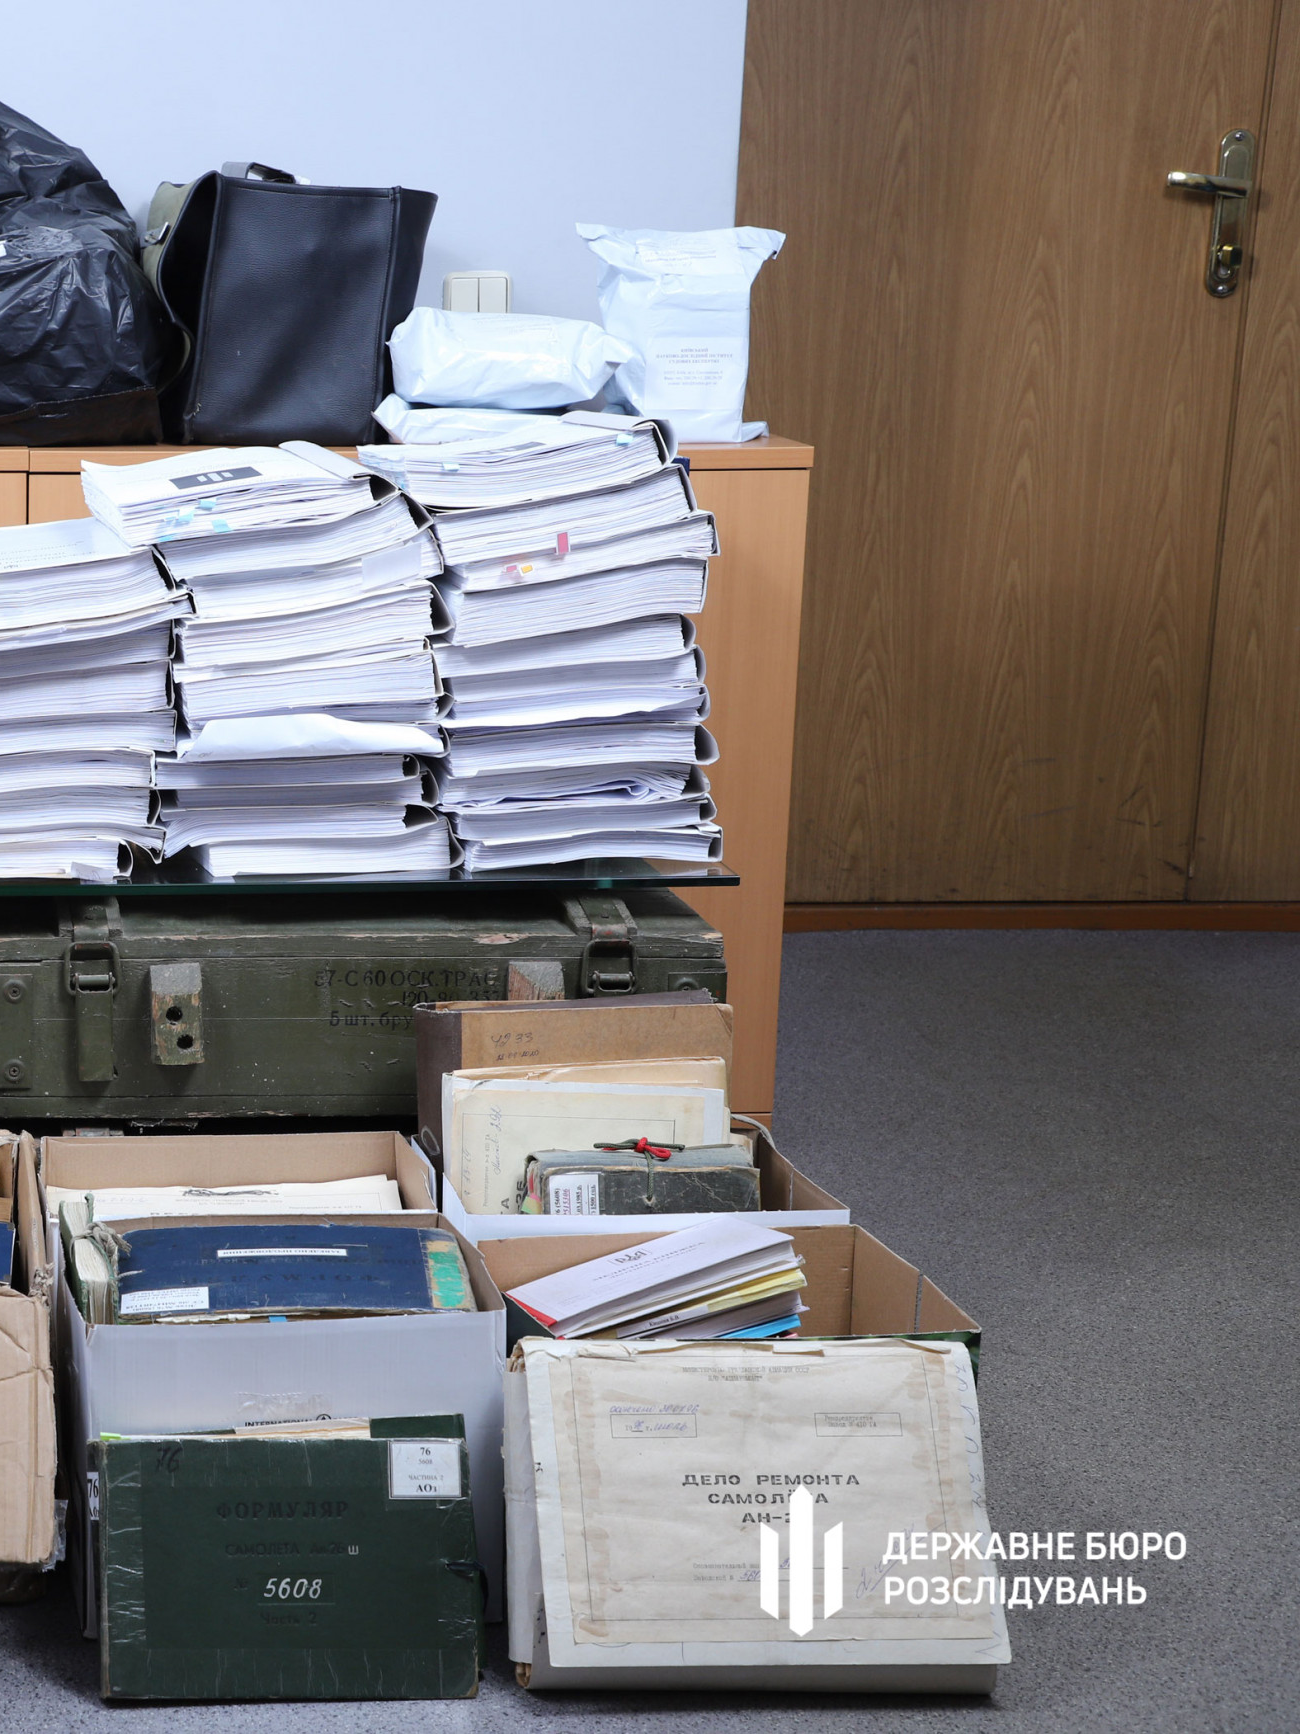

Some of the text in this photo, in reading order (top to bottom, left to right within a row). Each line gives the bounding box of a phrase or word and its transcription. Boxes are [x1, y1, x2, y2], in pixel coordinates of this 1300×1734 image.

[363, 970, 386, 987] 60
[329, 1010, 340, 1027] 5
[419, 1447, 432, 1457] 76
[87, 1478, 99, 1499] 76
[681, 1474, 861, 1487] ДЕЛО РЕМОНТА
[215, 1500, 350, 1521] ФОРМУЛЯР
[263, 1577, 323, 1600] 5608
